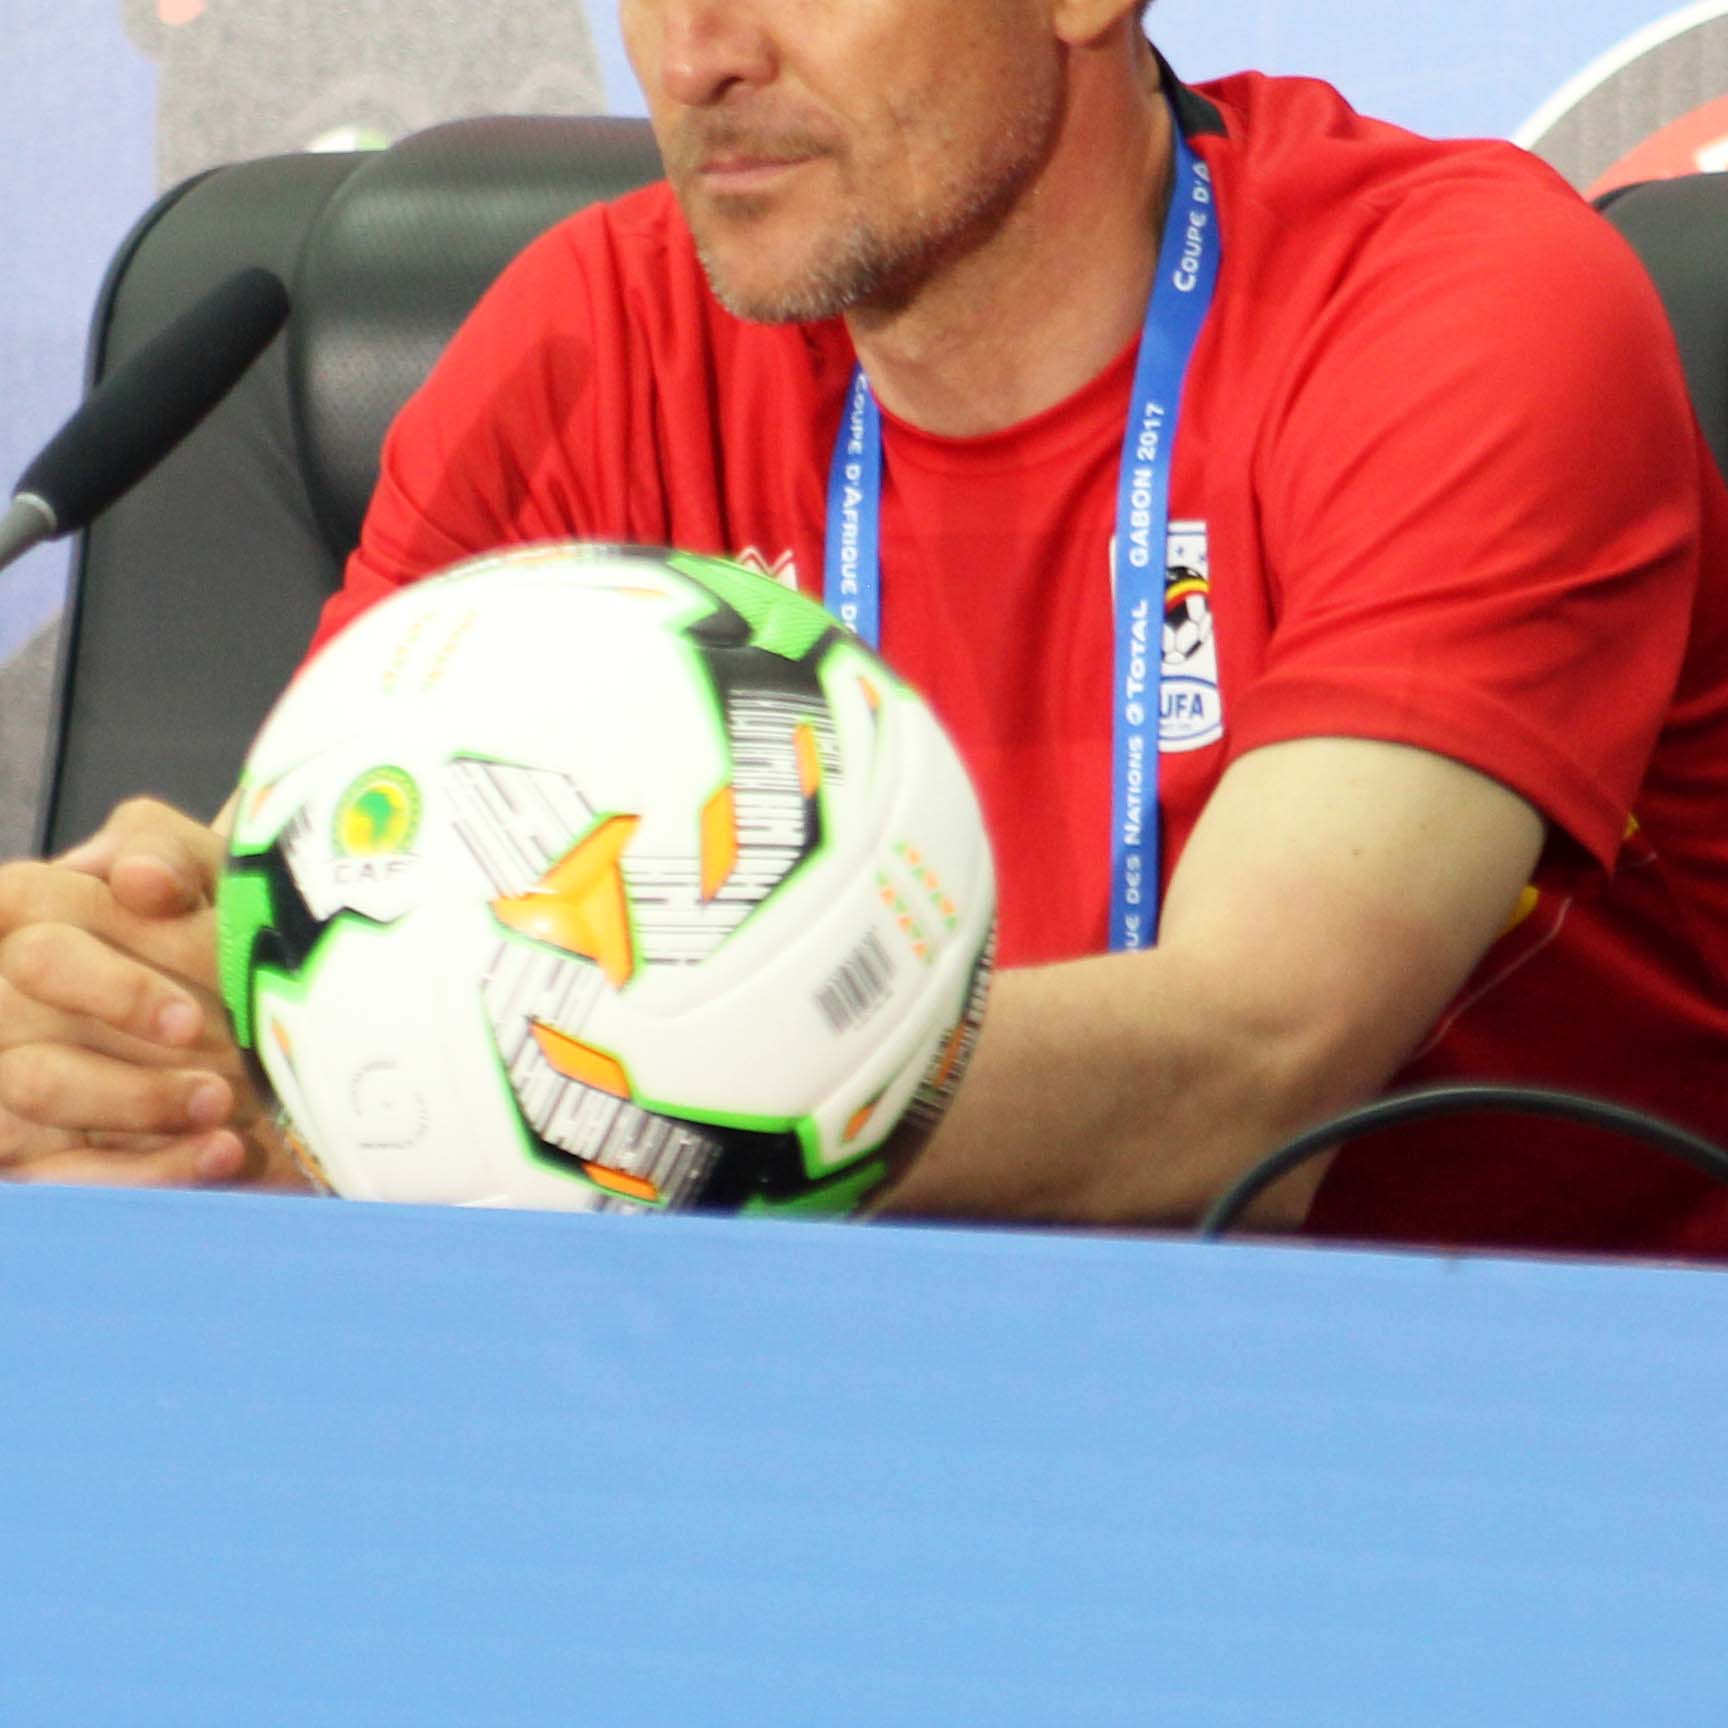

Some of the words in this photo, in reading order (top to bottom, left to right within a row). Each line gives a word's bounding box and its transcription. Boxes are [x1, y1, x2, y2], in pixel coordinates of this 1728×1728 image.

[1173, 210, 1208, 293] COUPE
[847, 372, 868, 456] COUPE
[1136, 402, 1166, 463] 2017
[839, 463, 864, 596] D'AFRIQUE
[1128, 469, 1154, 569] GABON
[1125, 597, 1150, 700] TOTAL
[1123, 735, 1144, 846] NATIONS
[1125, 855, 1142, 905] DES
